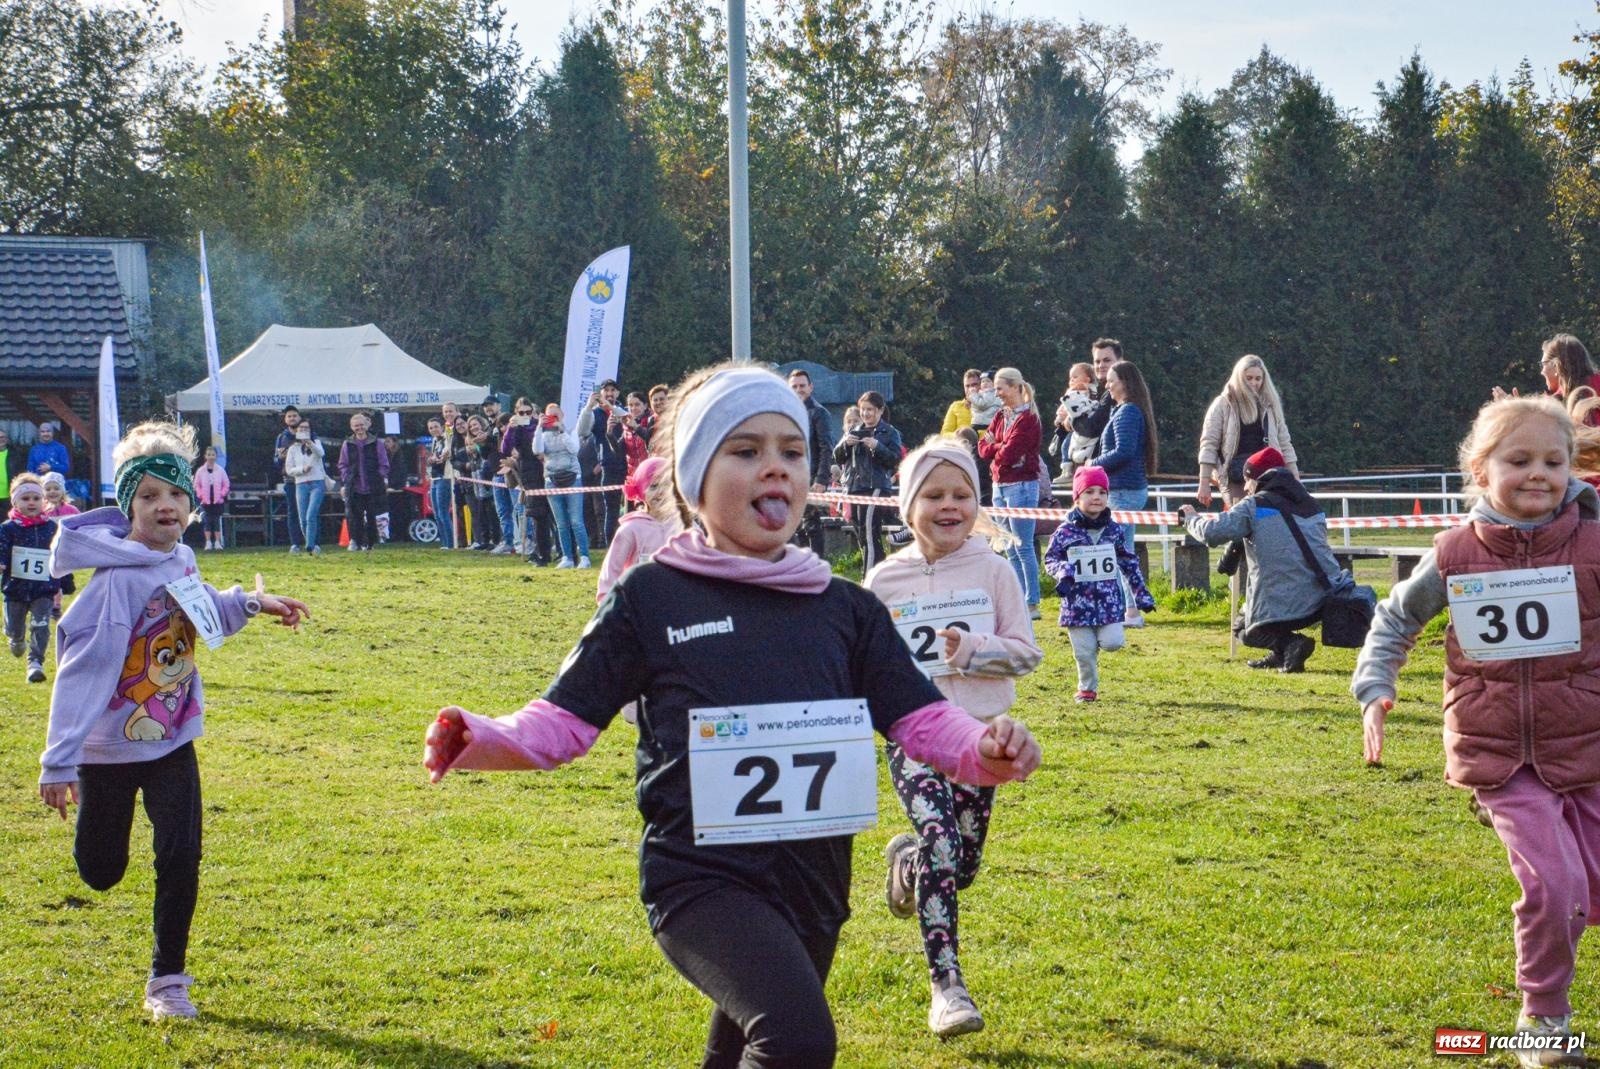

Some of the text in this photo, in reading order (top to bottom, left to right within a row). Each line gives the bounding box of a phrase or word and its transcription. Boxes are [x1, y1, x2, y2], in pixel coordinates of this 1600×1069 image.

[232, 392, 440, 407] STOWARZYSZENIE AKTYWNI DLA LEPSZEGO JUTRA
[20, 559, 44, 575] 15
[1074, 557, 1114, 575] 116
[1488, 575, 1569, 590] www.personalbest.pl
[921, 596, 989, 612] www.personalbest.pl
[666, 615, 734, 646] hummel
[1476, 601, 1550, 644] 30
[757, 713, 864, 731] www.personalbest.pl
[733, 750, 837, 817] 27
